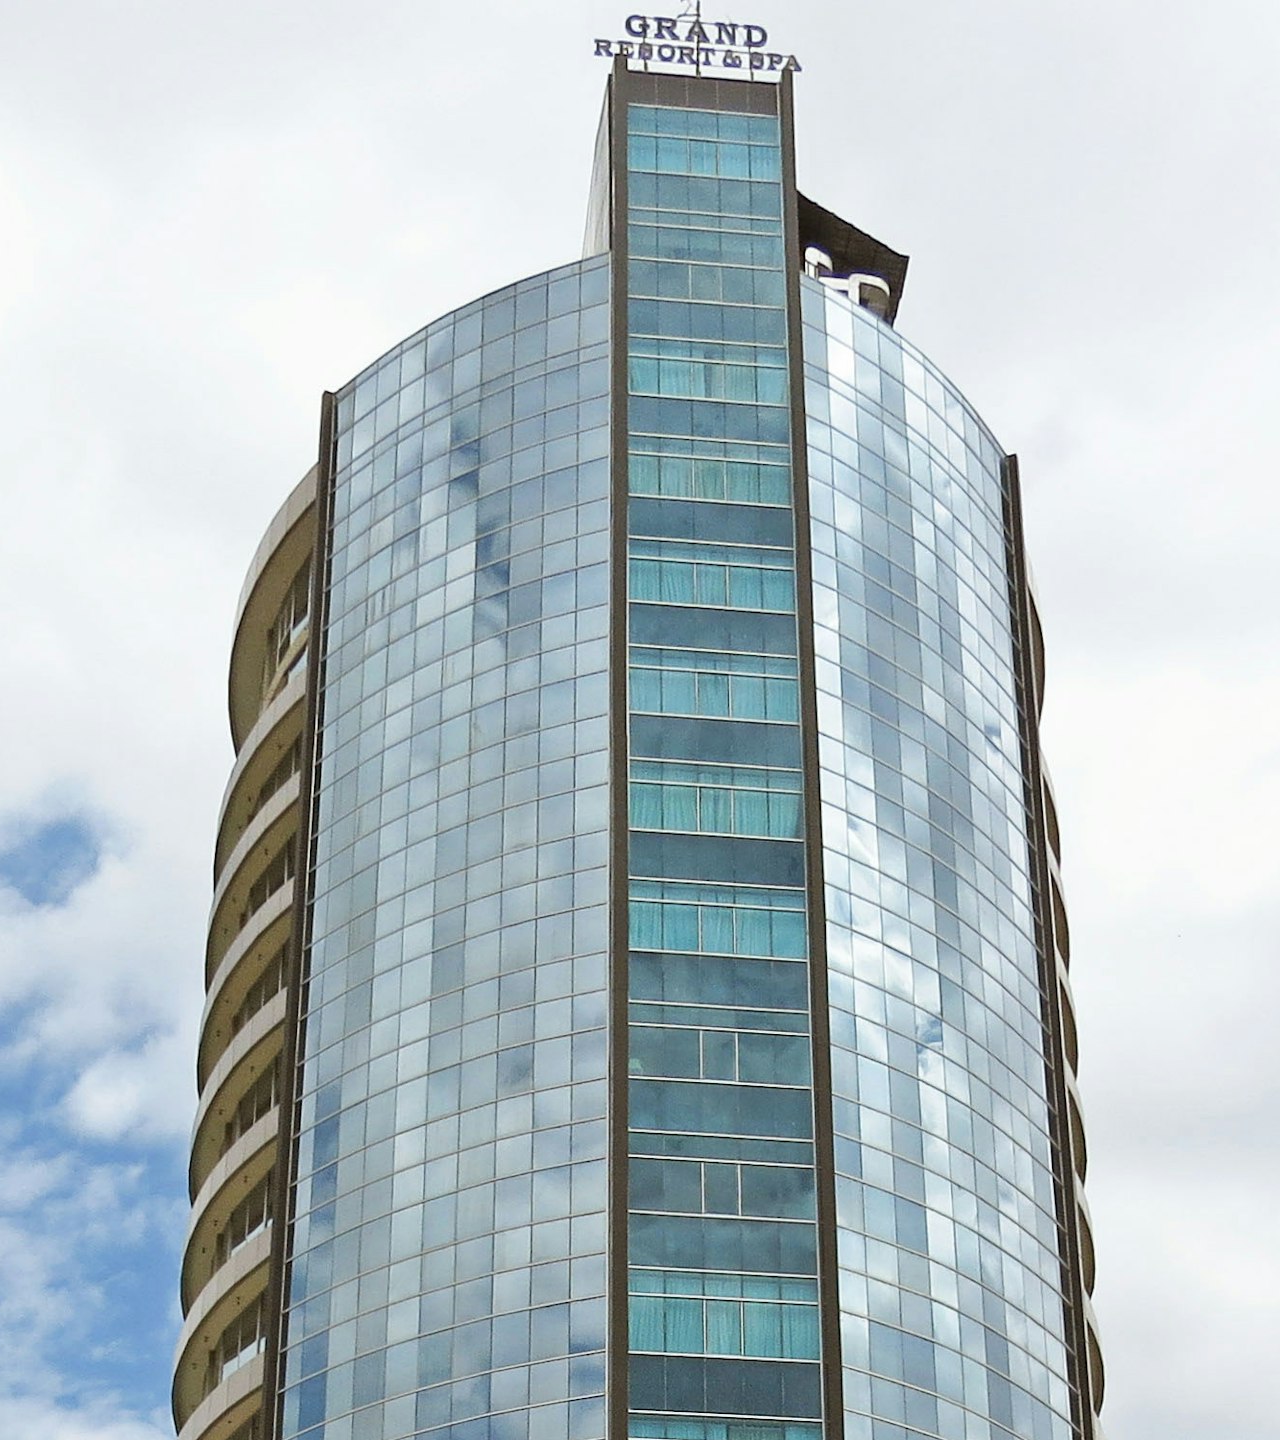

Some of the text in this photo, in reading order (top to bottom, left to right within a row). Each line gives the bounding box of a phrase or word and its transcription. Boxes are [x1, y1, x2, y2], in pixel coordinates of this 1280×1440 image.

[625, 14, 768, 48] GRAND
[594, 38, 803, 72] RESORT & SPA
